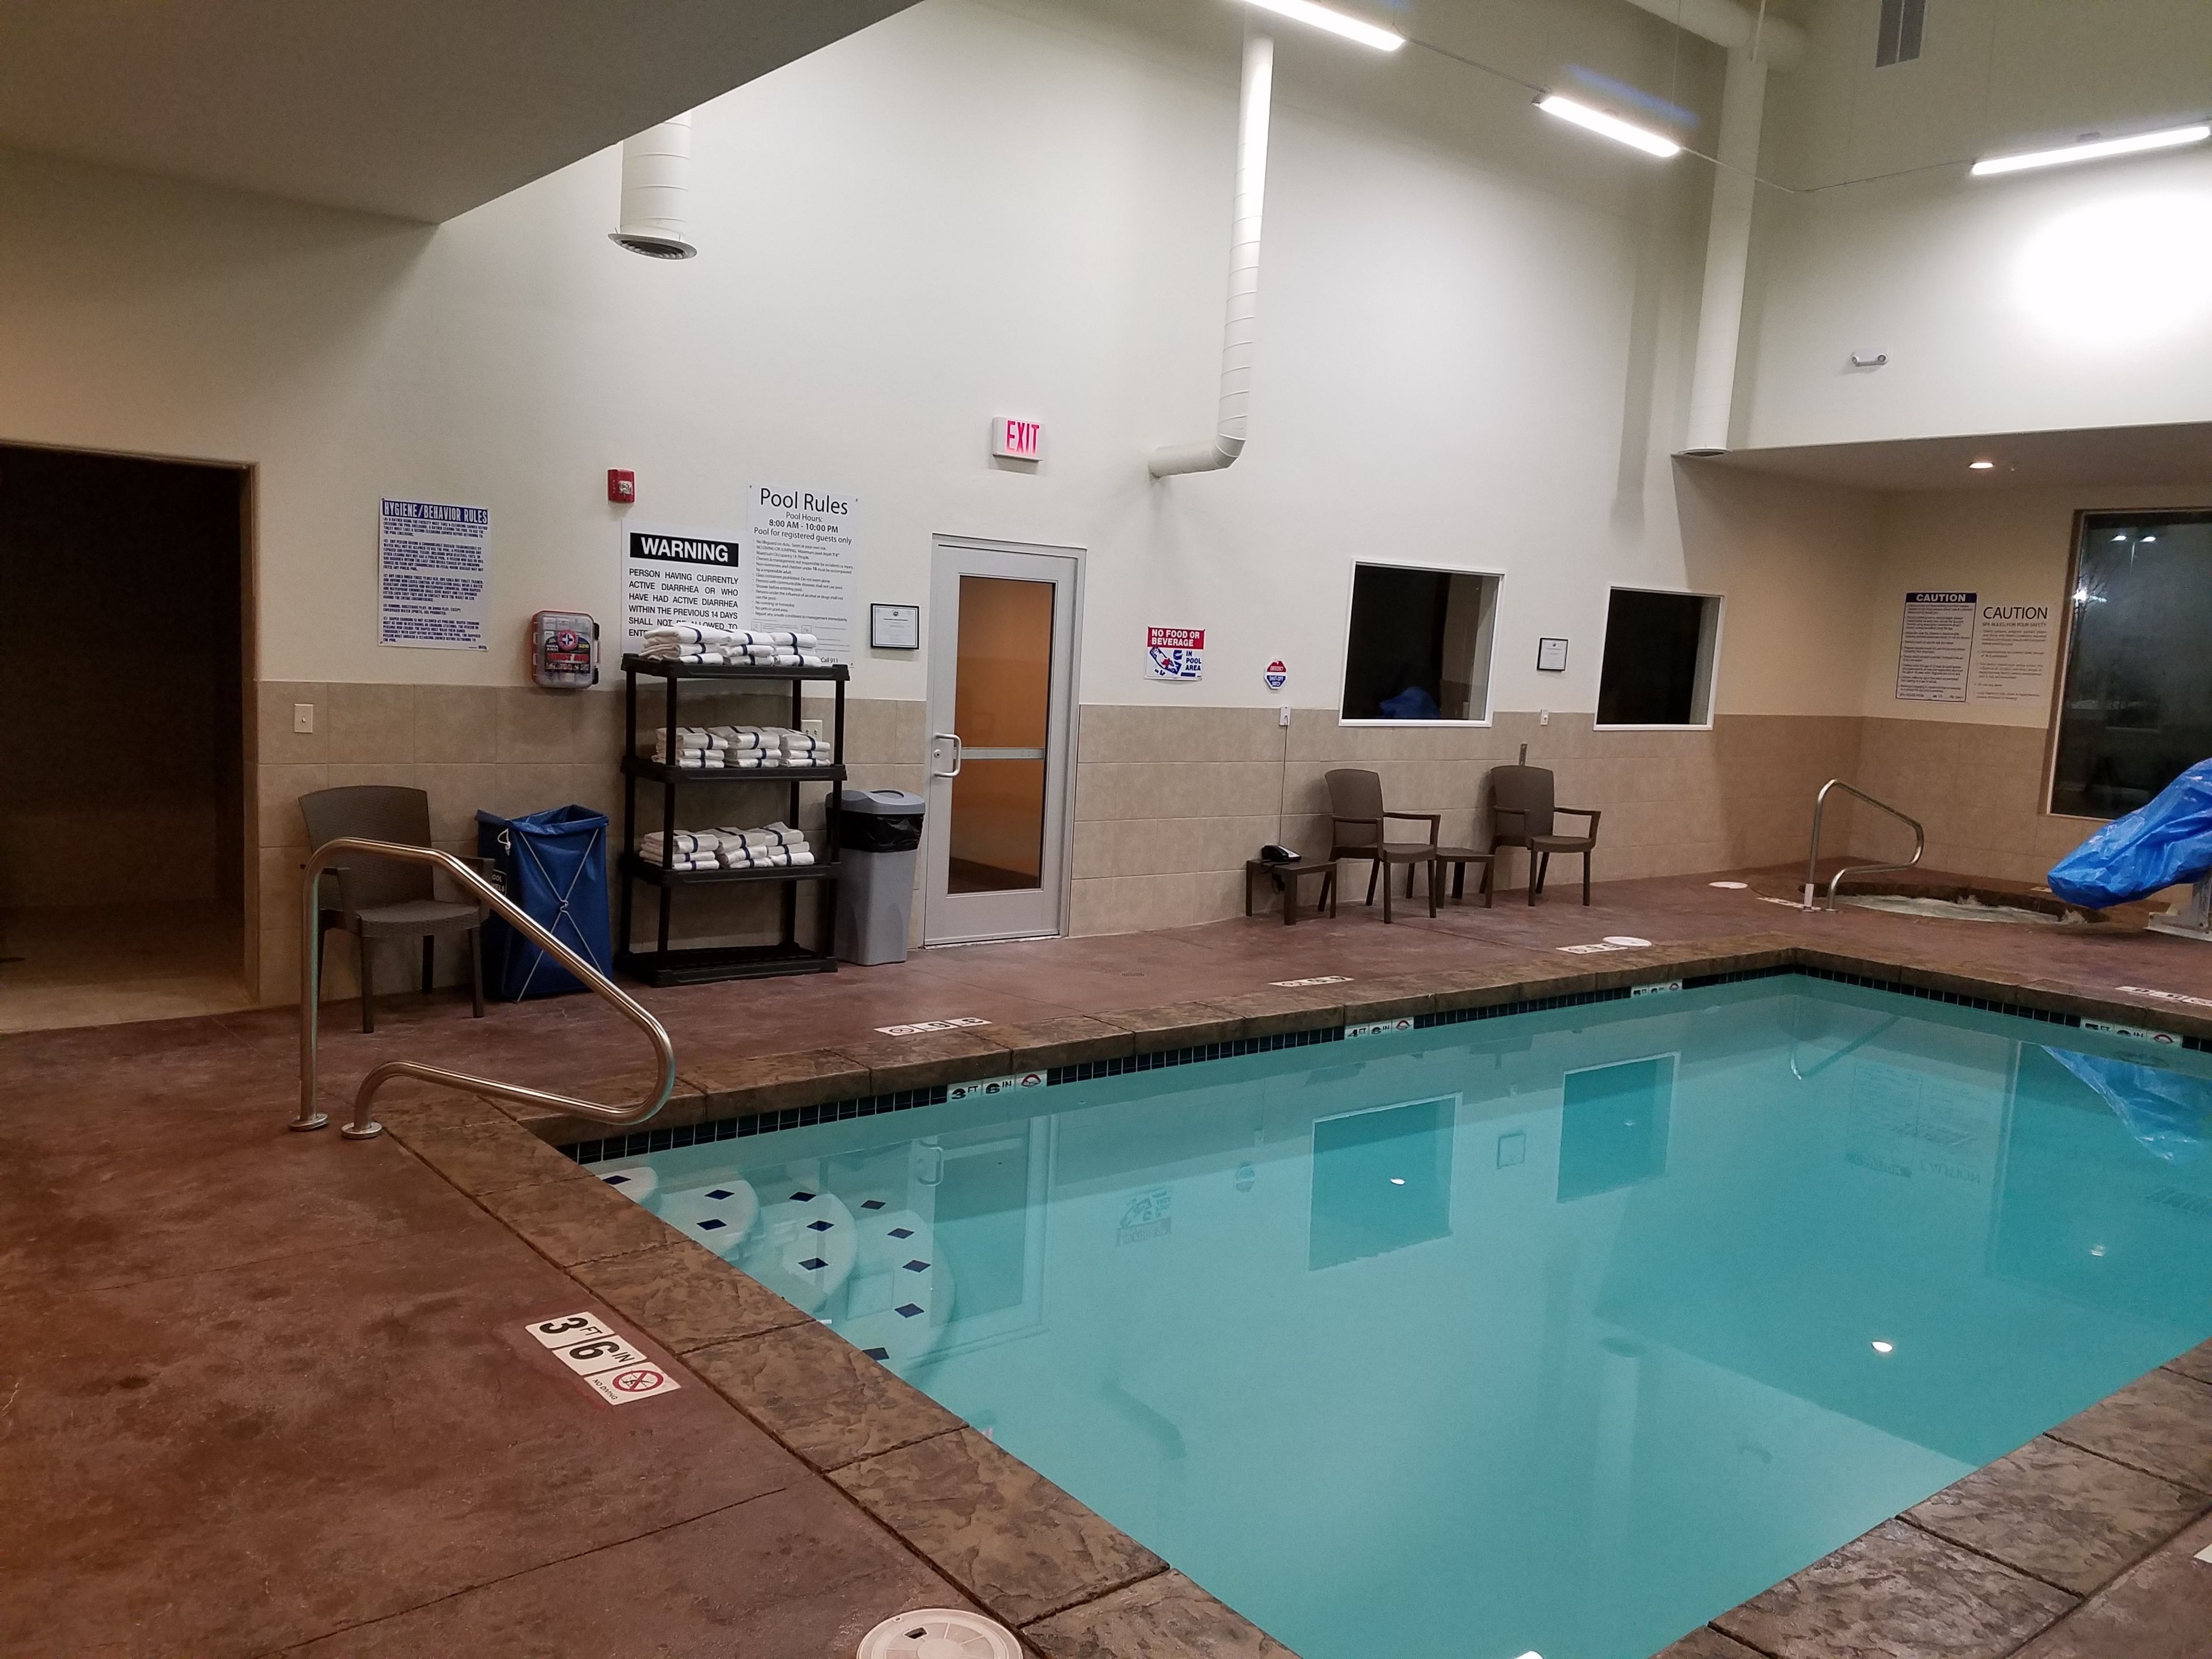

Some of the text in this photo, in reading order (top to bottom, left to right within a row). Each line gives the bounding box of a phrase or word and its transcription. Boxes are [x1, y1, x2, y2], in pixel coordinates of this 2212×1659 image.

[1006, 420, 1039, 454] EXIT
[760, 487, 848, 515] Pool Rules
[384, 501, 487, 524] HYGIENE/BEHAVIOR RULES
[786, 512, 823, 522] Pool Hours:
[769, 519, 785, 528] 8:00
[806, 523, 825, 532] 10:00
[754, 527, 852, 545] Pool for registered guests only
[641, 536, 728, 562] WARNING
[629, 569, 738, 585] PERSON HAVING CURRENTLY
[629, 581, 655, 589] ACTIVE
[661, 583, 699, 593] DIARRHEA
[721, 588, 738, 596] WHO
[629, 593, 738, 608] HAVE HAD ACTIVE DIARRHEA
[1916, 594, 1965, 602] CAUTION
[628, 605, 655, 613] WITHIN
[657, 607, 672, 615] THE
[673, 608, 709, 617] PREVIOUS
[720, 611, 738, 619] DAYS
[1983, 607, 2048, 619] CAUTION
[628, 617, 653, 625] SHALL
[1152, 628, 1200, 639] NO FOOD OR
[1152, 637, 1194, 646] BEVERAGE
[1372, 1027, 1381, 1035] 6
[951, 1088, 966, 1100] 3
[986, 1083, 1001, 1094] 6
[539, 1317, 635, 1363] 3 FT 6 IN
[600, 1385, 618, 1400] DIVING
